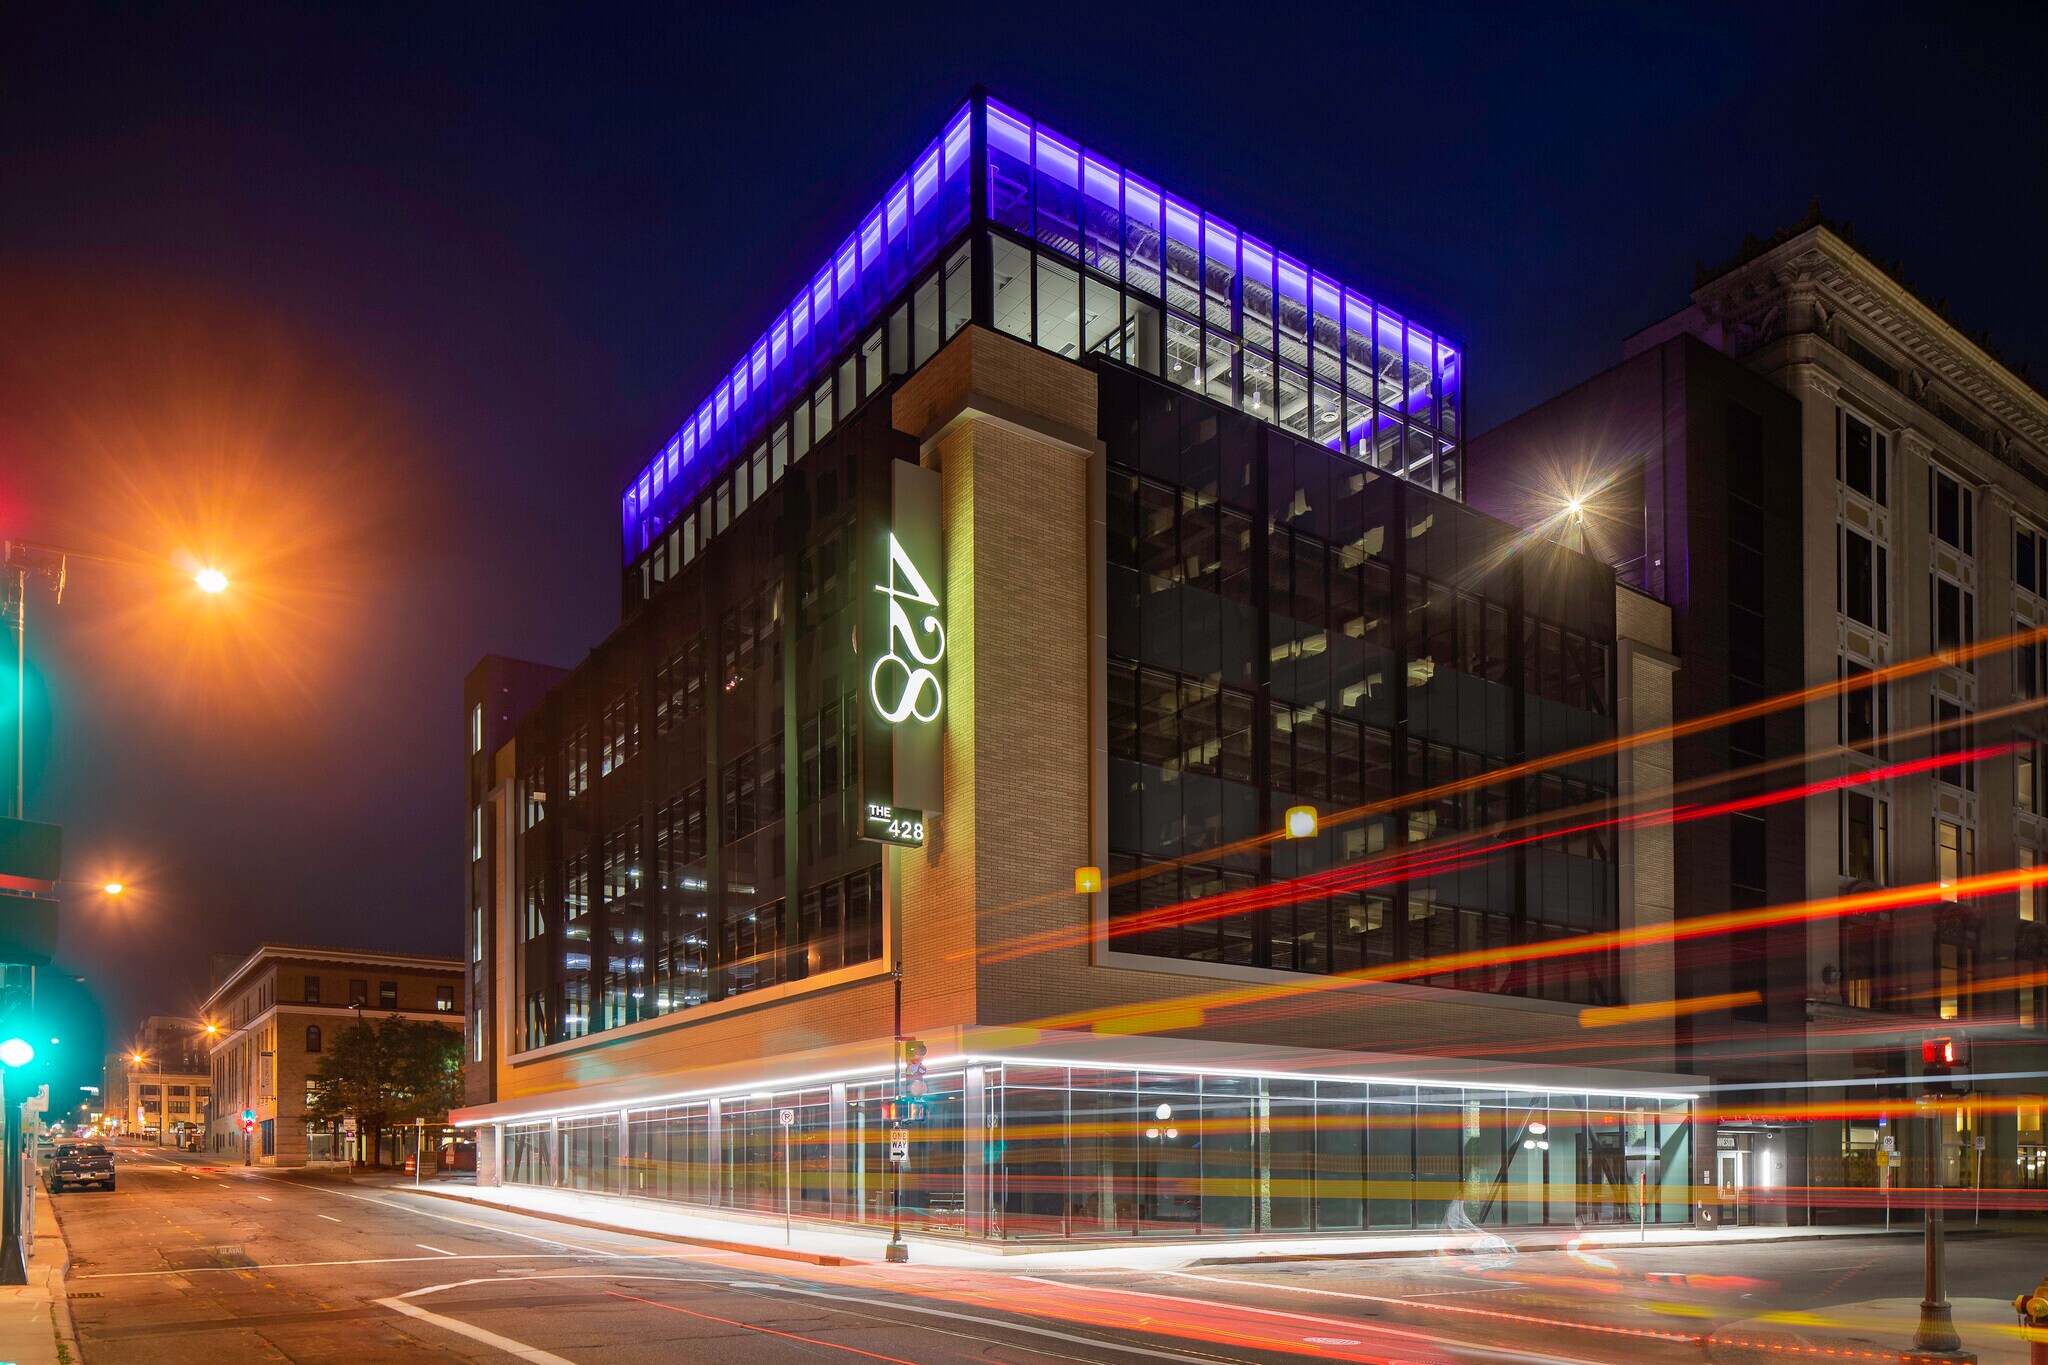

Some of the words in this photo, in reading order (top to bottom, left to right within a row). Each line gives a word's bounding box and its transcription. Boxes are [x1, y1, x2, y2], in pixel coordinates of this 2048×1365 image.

[870, 533, 945, 722] 428
[869, 804, 891, 818] THE
[888, 819, 924, 840] 428
[892, 1131, 907, 1141] ONE
[892, 1141, 907, 1149] WAY
